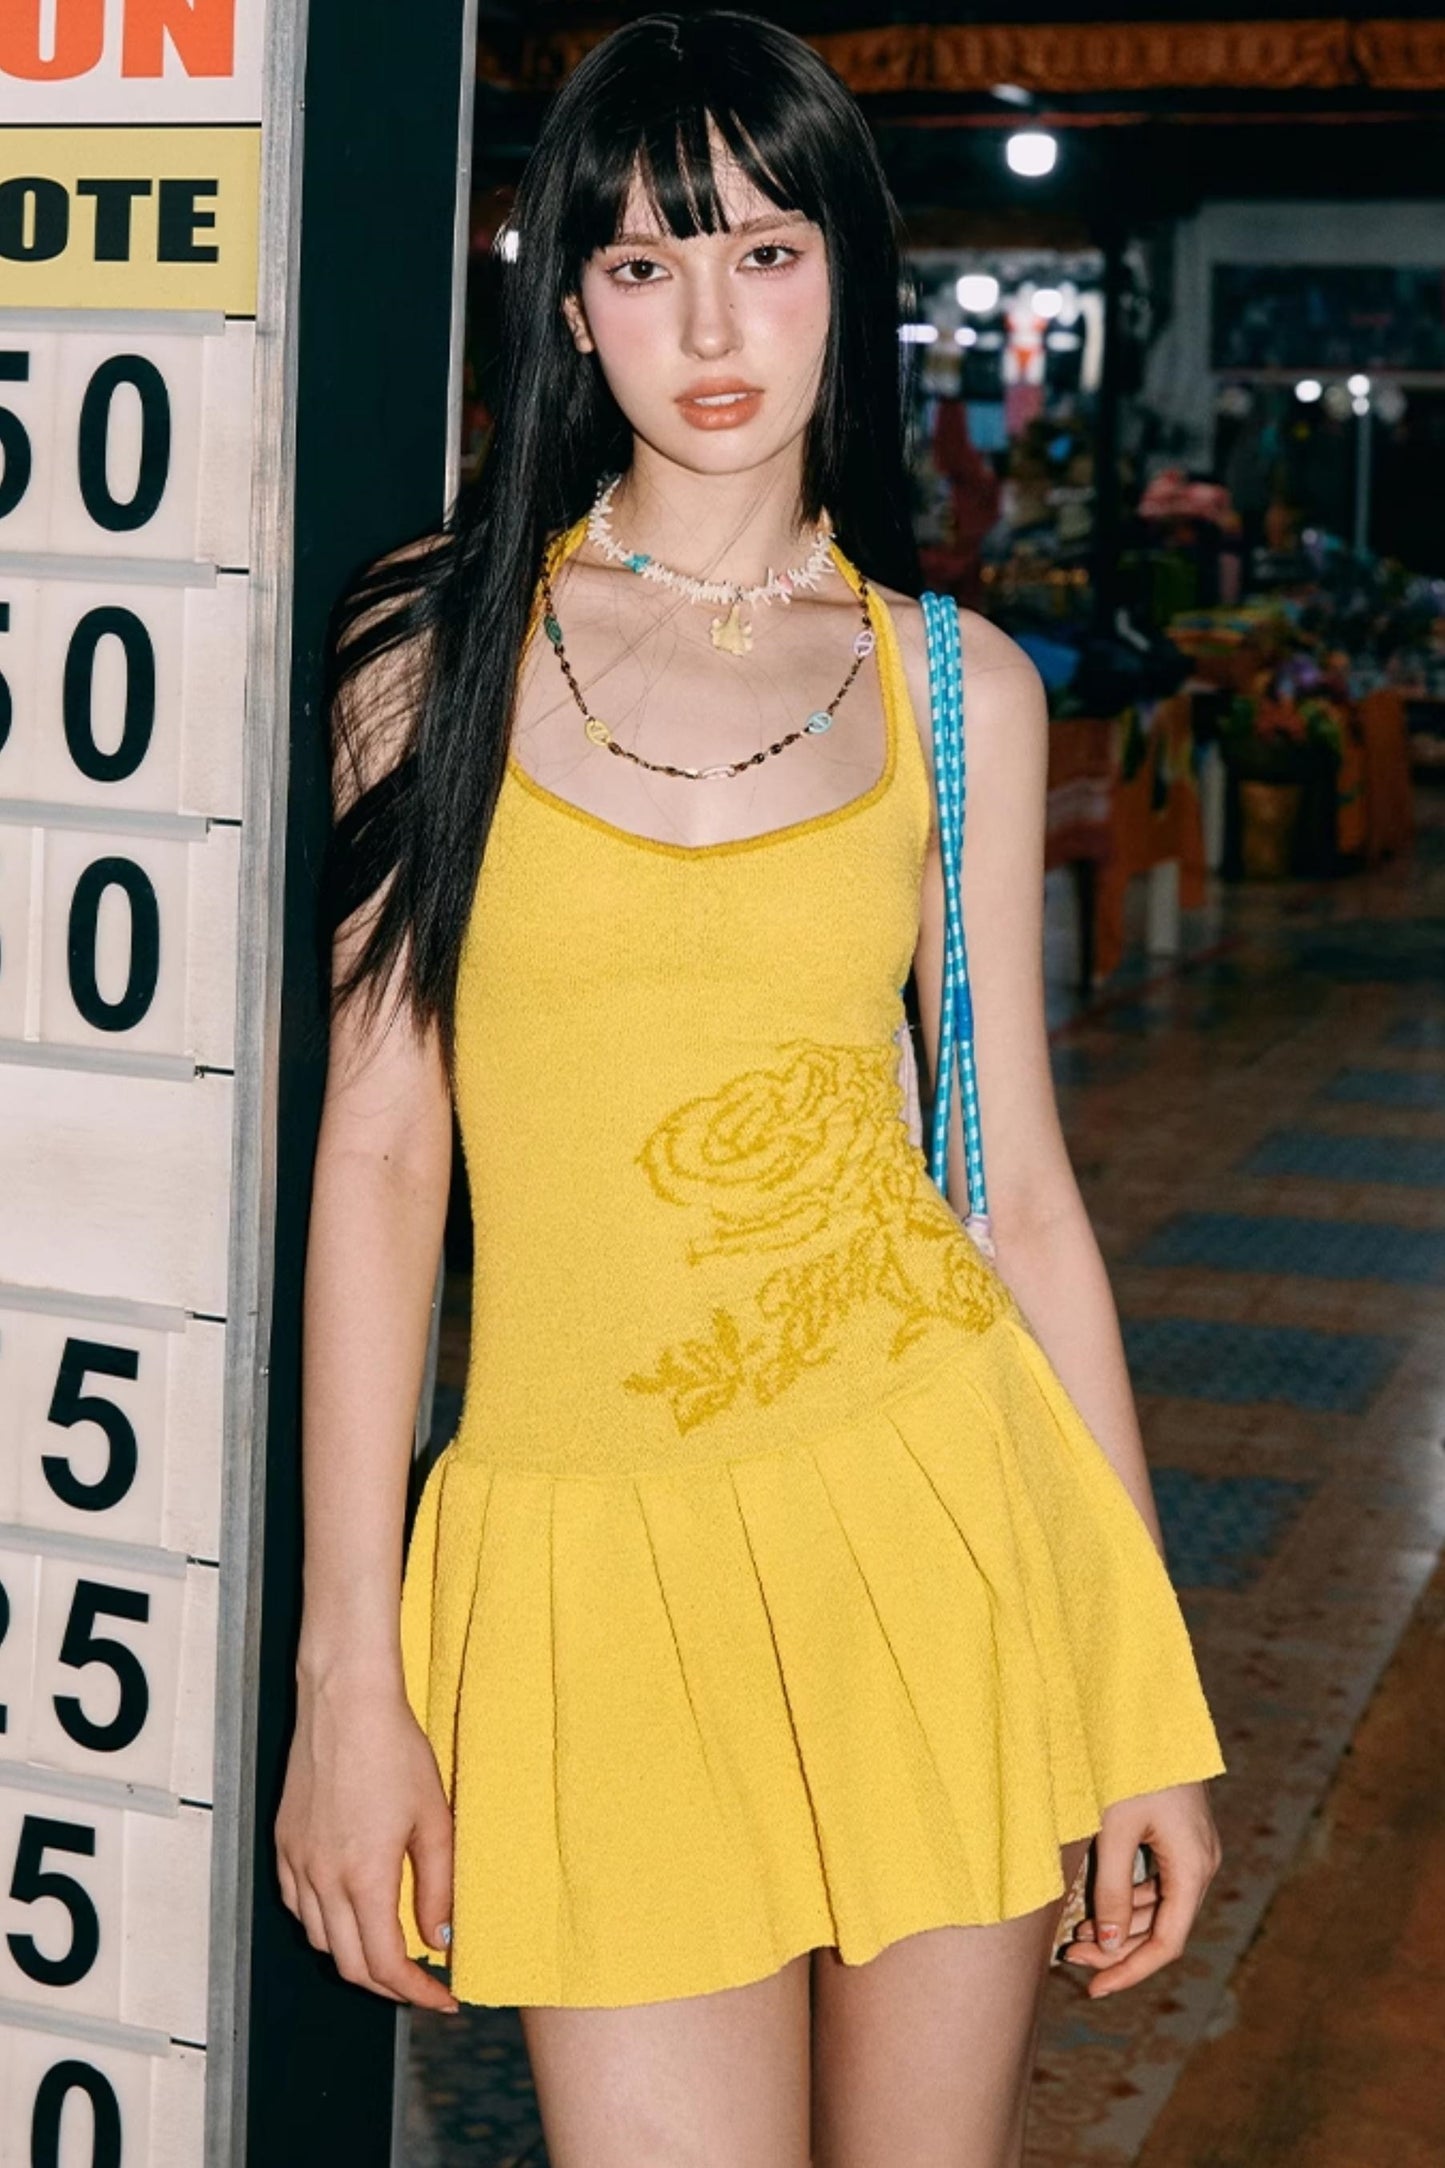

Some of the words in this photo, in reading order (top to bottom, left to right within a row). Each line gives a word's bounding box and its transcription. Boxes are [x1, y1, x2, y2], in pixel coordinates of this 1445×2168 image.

[0, 177, 219, 263] OTE
[0, 601, 156, 783] 0
[0, 1580, 150, 1753] 5
[6, 1814, 100, 1987] 5
[31, 2059, 122, 2168] 0
